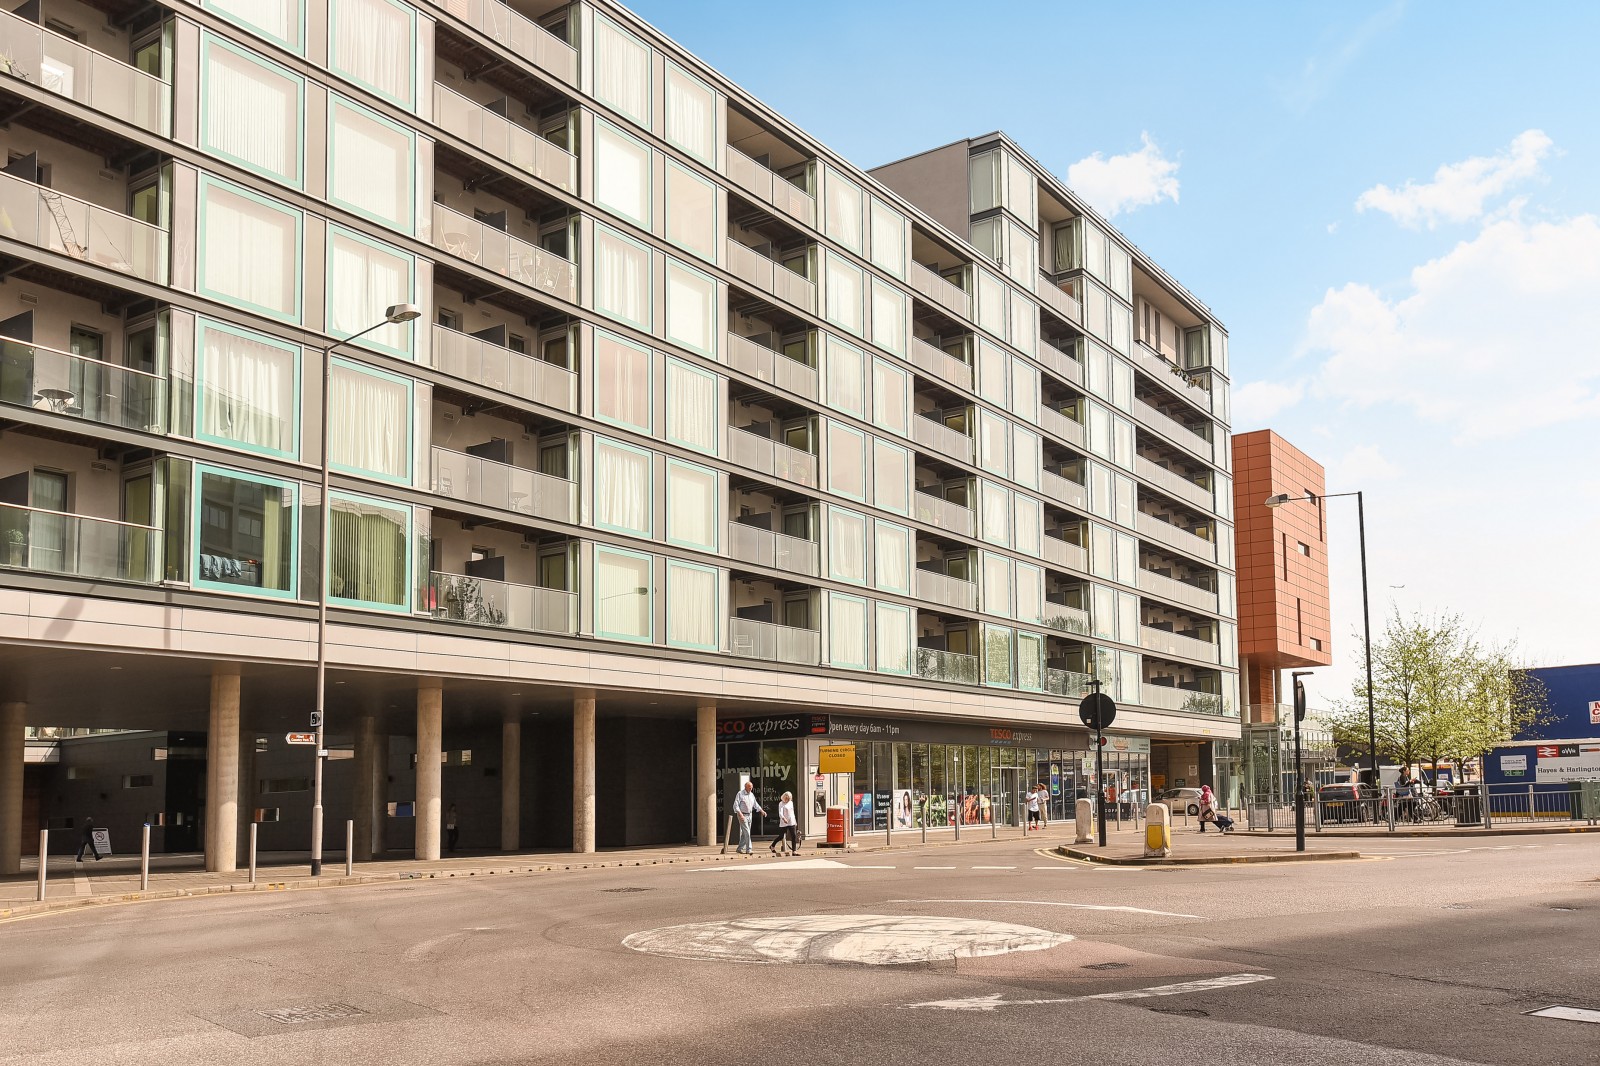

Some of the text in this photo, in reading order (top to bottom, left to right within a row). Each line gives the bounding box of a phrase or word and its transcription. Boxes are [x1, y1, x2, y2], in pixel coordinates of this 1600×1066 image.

[716, 718, 800, 736] SCO express
[843, 724, 859, 734] every
[859, 723, 870, 734] day
[869, 723, 882, 733] 6am
[885, 724, 900, 736] 11pm
[990, 728, 1032, 743] TESCO express
